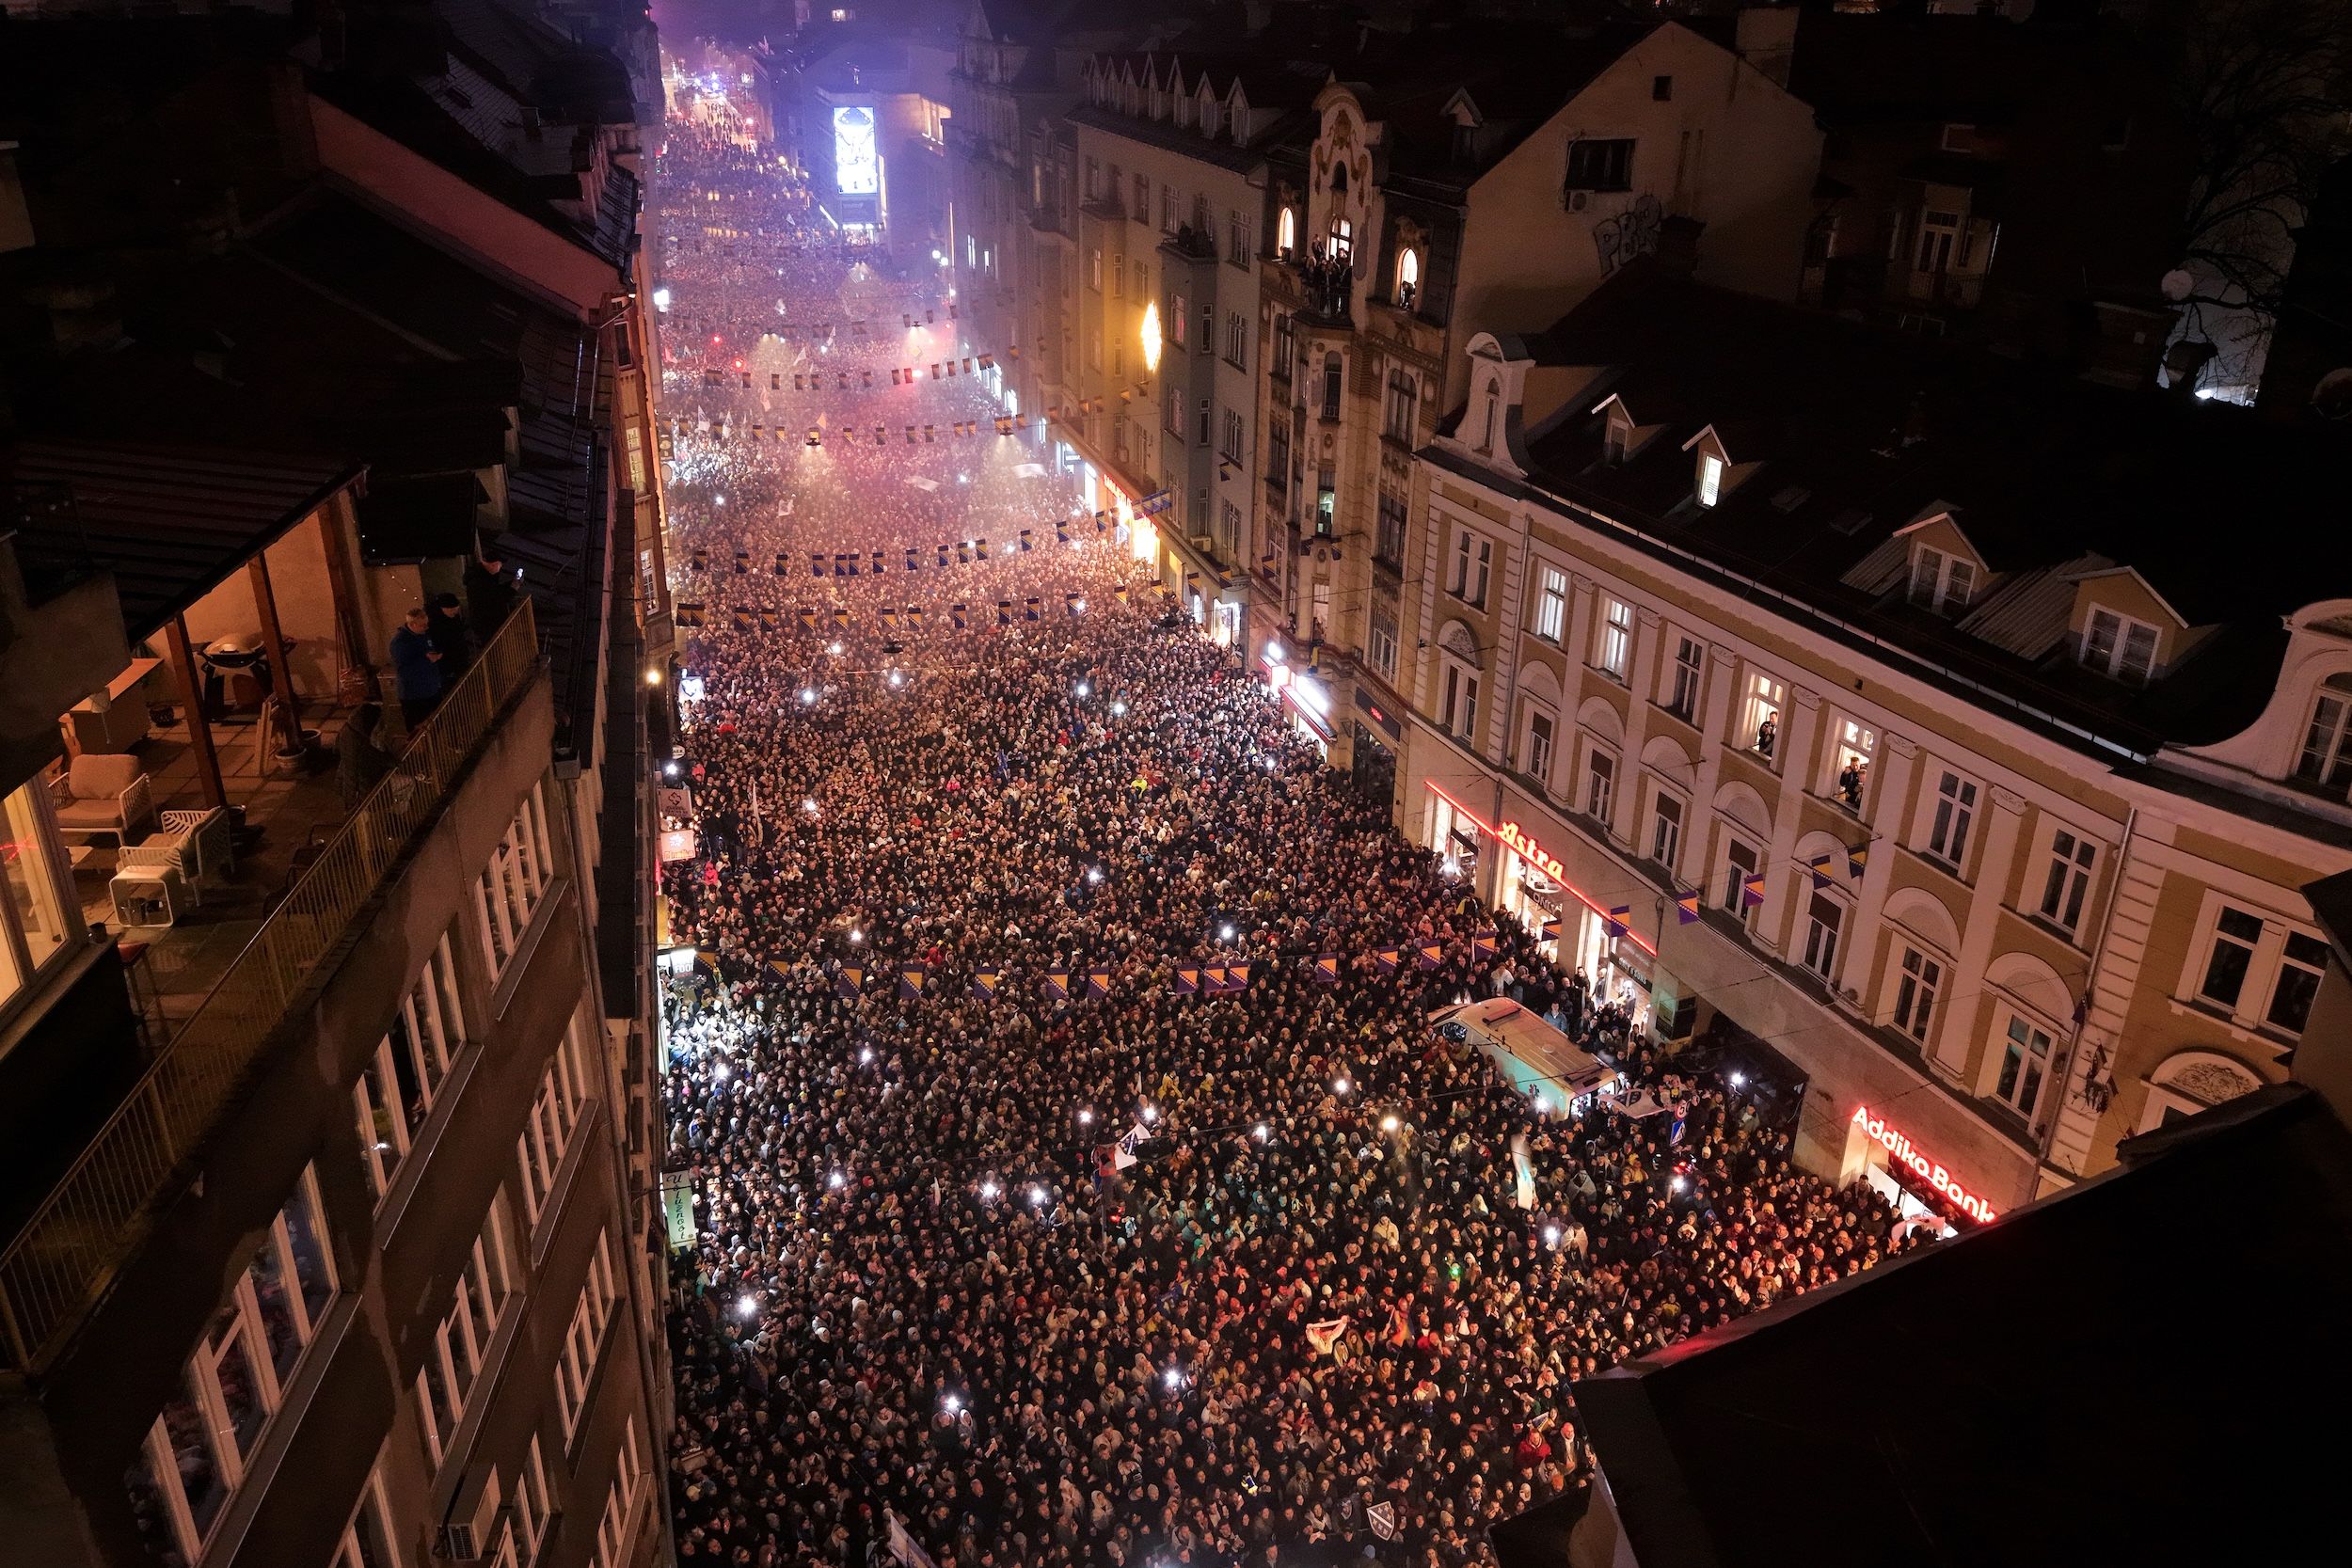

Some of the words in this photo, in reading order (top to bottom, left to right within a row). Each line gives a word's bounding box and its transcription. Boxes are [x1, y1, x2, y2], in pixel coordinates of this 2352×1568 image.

[1498, 820, 1565, 879] Astra
[1851, 1106, 1931, 1178] Addiko
[1931, 1164, 1995, 1224] Bank
